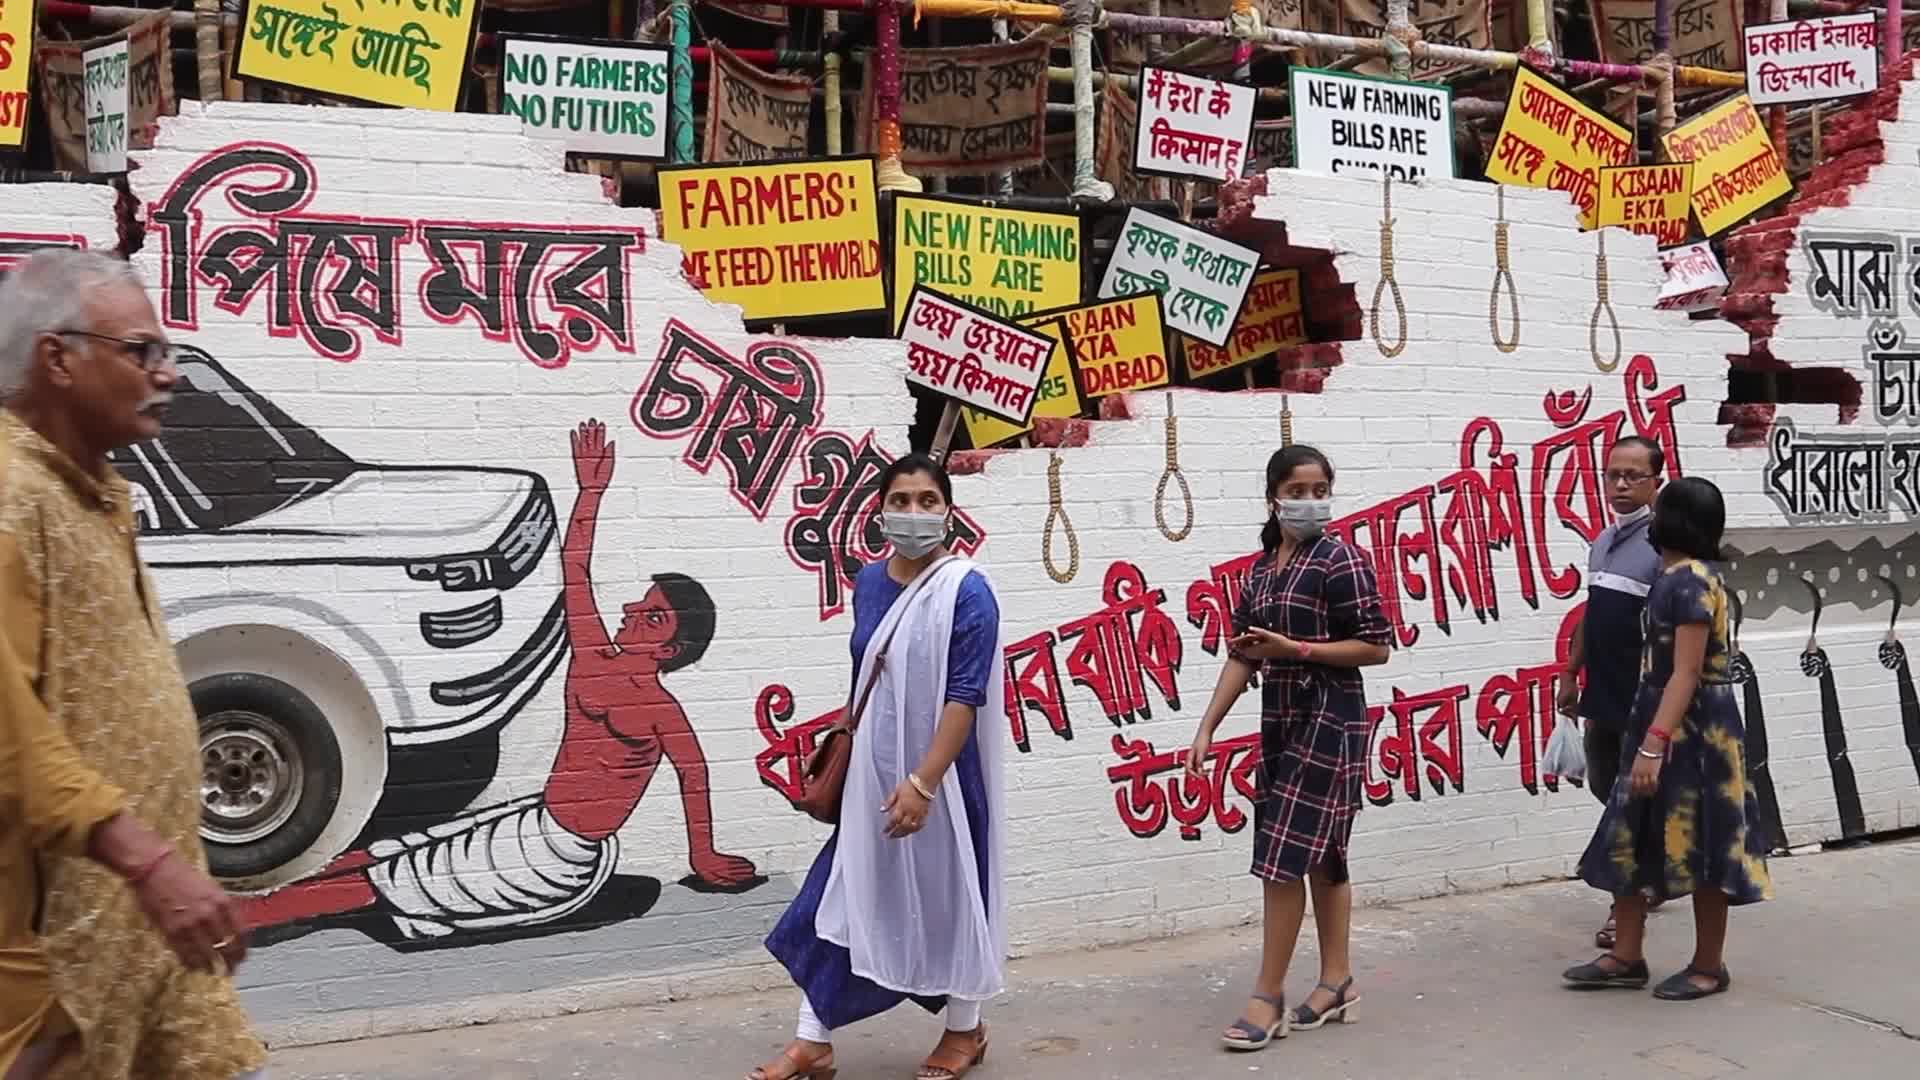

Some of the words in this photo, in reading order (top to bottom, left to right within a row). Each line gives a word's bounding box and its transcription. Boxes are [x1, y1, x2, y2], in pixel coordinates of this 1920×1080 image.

[352, 21, 441, 97] আছি
[506, 53, 547, 86] NO
[555, 55, 668, 95] FARMERS
[503, 93, 547, 127] NO
[552, 96, 656, 137] FUTURS
[1207, 80, 1232, 119] के
[1308, 79, 1357, 111] NEW
[1363, 87, 1442, 121] FARMING
[1150, 117, 1225, 168] किसान
[1332, 119, 1385, 150] BILLS
[1389, 126, 1427, 155] ARE
[678, 172, 858, 230] FARMERS:
[1612, 167, 1683, 198] KISAAN
[1624, 198, 1666, 220] EKTA
[904, 208, 971, 251] NEW
[980, 216, 1077, 263] FARMING
[1126, 222, 1180, 264] কৃষক
[1626, 217, 1688, 246] DABAD
[146, 141, 413, 362] পিষে
[416, 216, 645, 369] মরে
[715, 247, 774, 288] FEED
[914, 250, 972, 287] BILLS
[991, 258, 1043, 292] ARE
[914, 298, 964, 341] জয়
[1069, 302, 1136, 337] SAAN
[1169, 287, 1229, 333] হোক
[1074, 333, 1118, 362] KTA
[908, 341, 960, 386] জয়
[952, 352, 1035, 414] কিশান
[1081, 354, 1166, 394] DABAD
[629, 317, 826, 522] চাষী
[1057, 560, 1184, 728] বাকি
